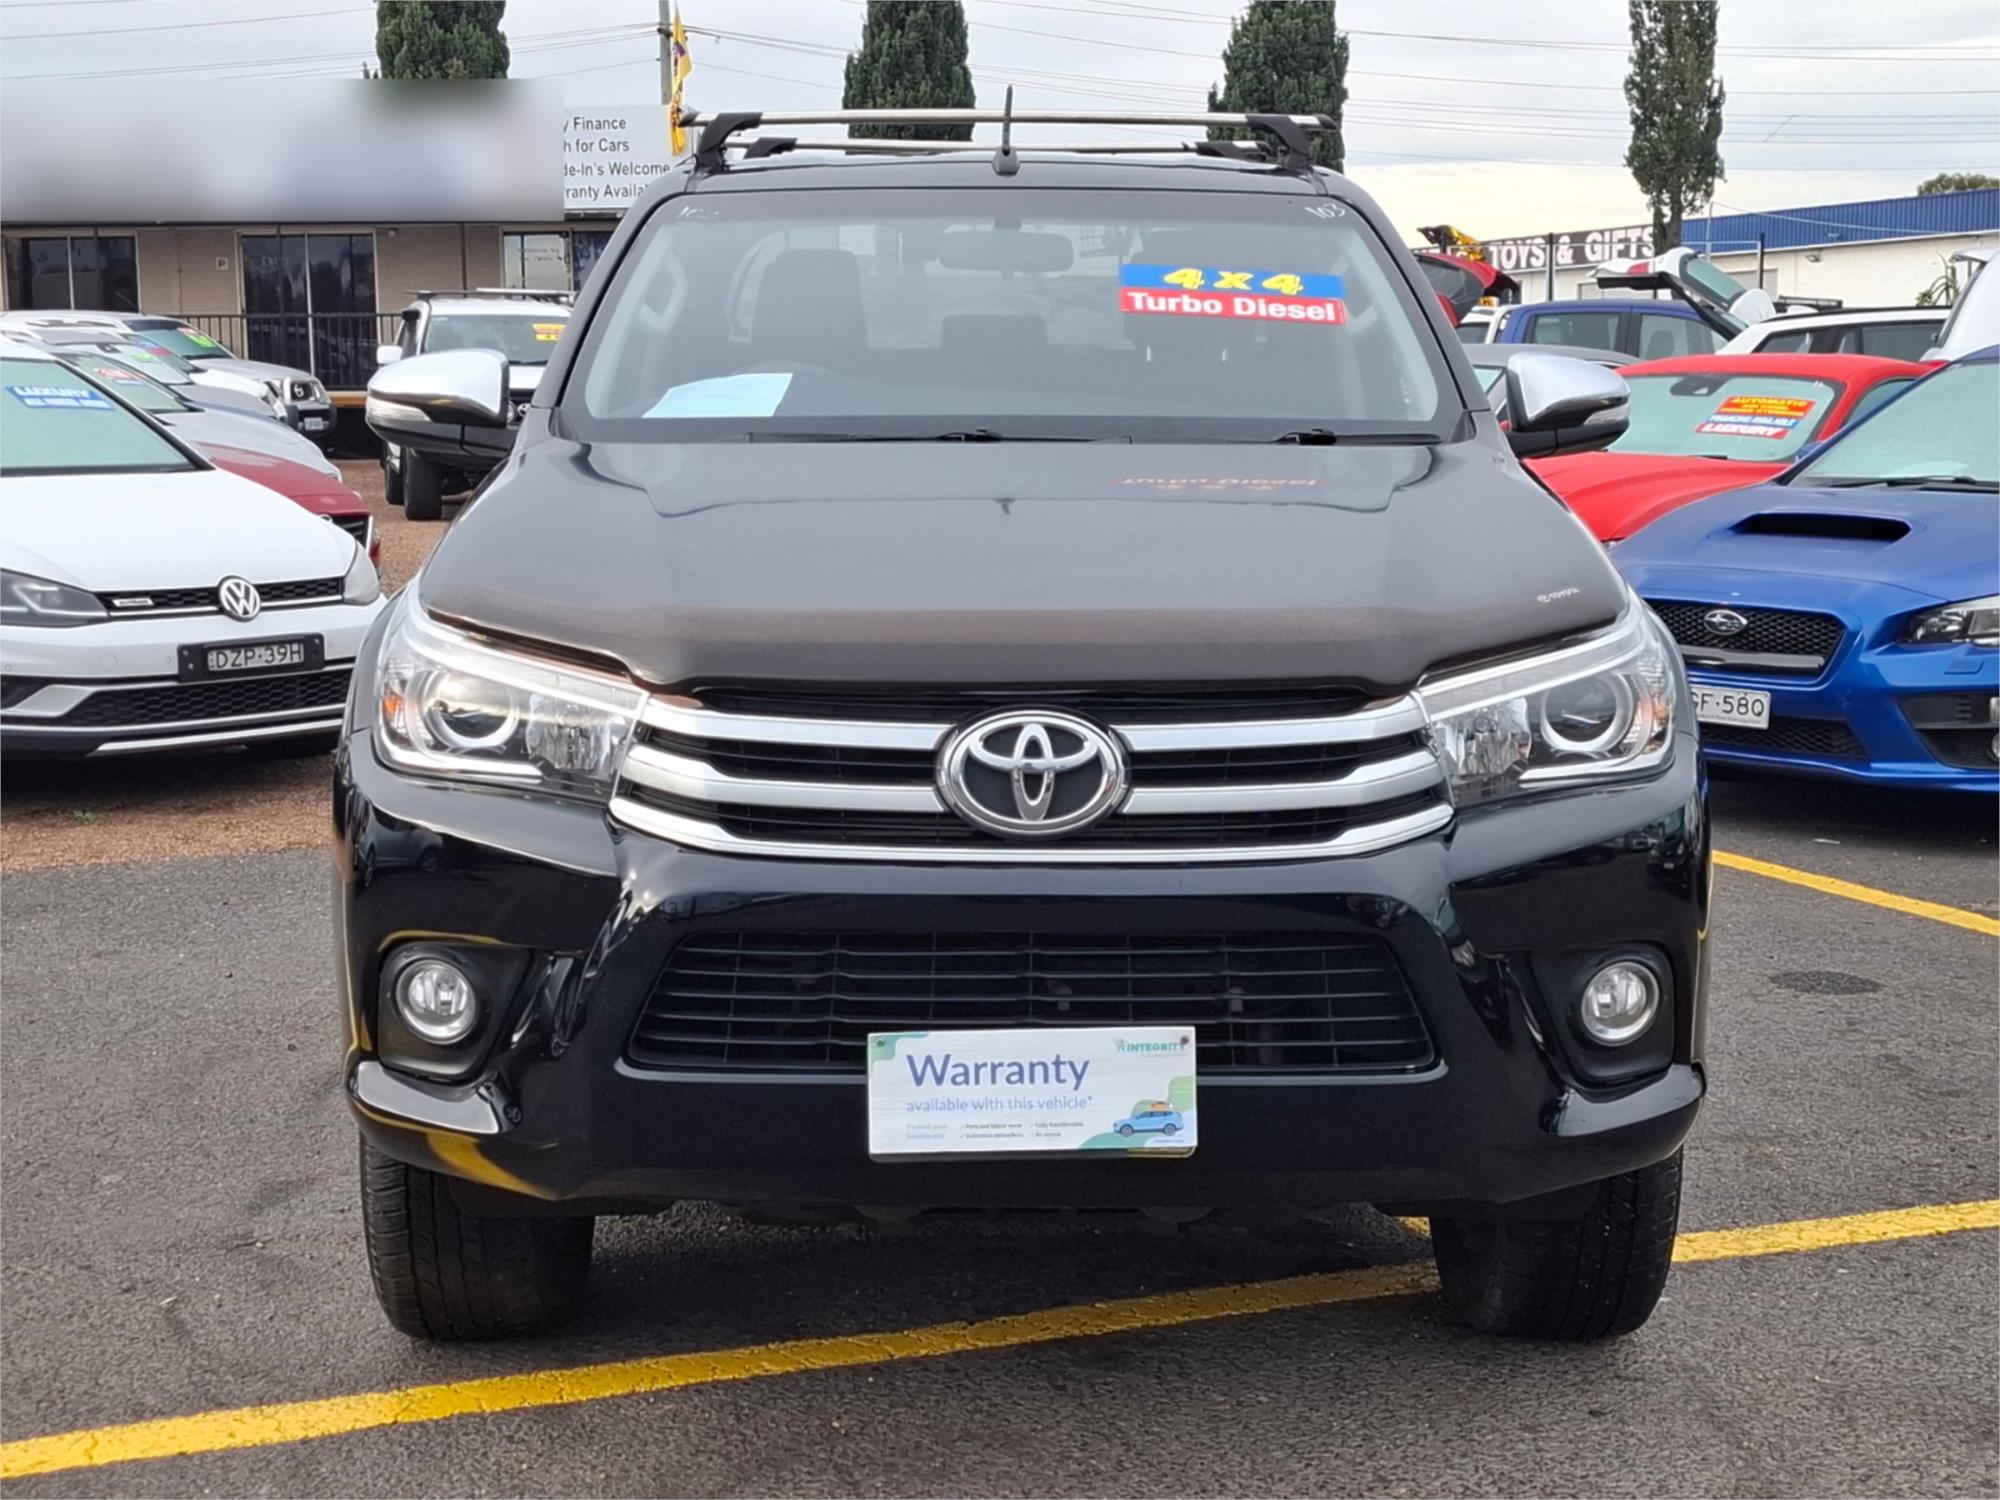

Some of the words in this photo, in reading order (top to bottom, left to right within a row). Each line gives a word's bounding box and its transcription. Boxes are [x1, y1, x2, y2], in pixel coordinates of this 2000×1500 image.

[573, 116, 627, 131] Finance
[576, 138, 595, 152] for
[598, 138, 630, 152] Cars
[608, 161, 671, 176] Welcome
[1487, 237, 1546, 269] TOYS
[1556, 235, 1574, 265] &
[1585, 227, 1654, 266] GIFTS
[1126, 291, 1223, 314] Turbo
[1233, 297, 1336, 322] Diesel
[1731, 397, 1809, 408] AUTOMATIC
[1700, 422, 1785, 437] LUXURY
[906, 1053, 1090, 1091] Warranty
[906, 1097, 968, 1112] available
[972, 1096, 1004, 1111] with
[1008, 1095, 1035, 1110] this
